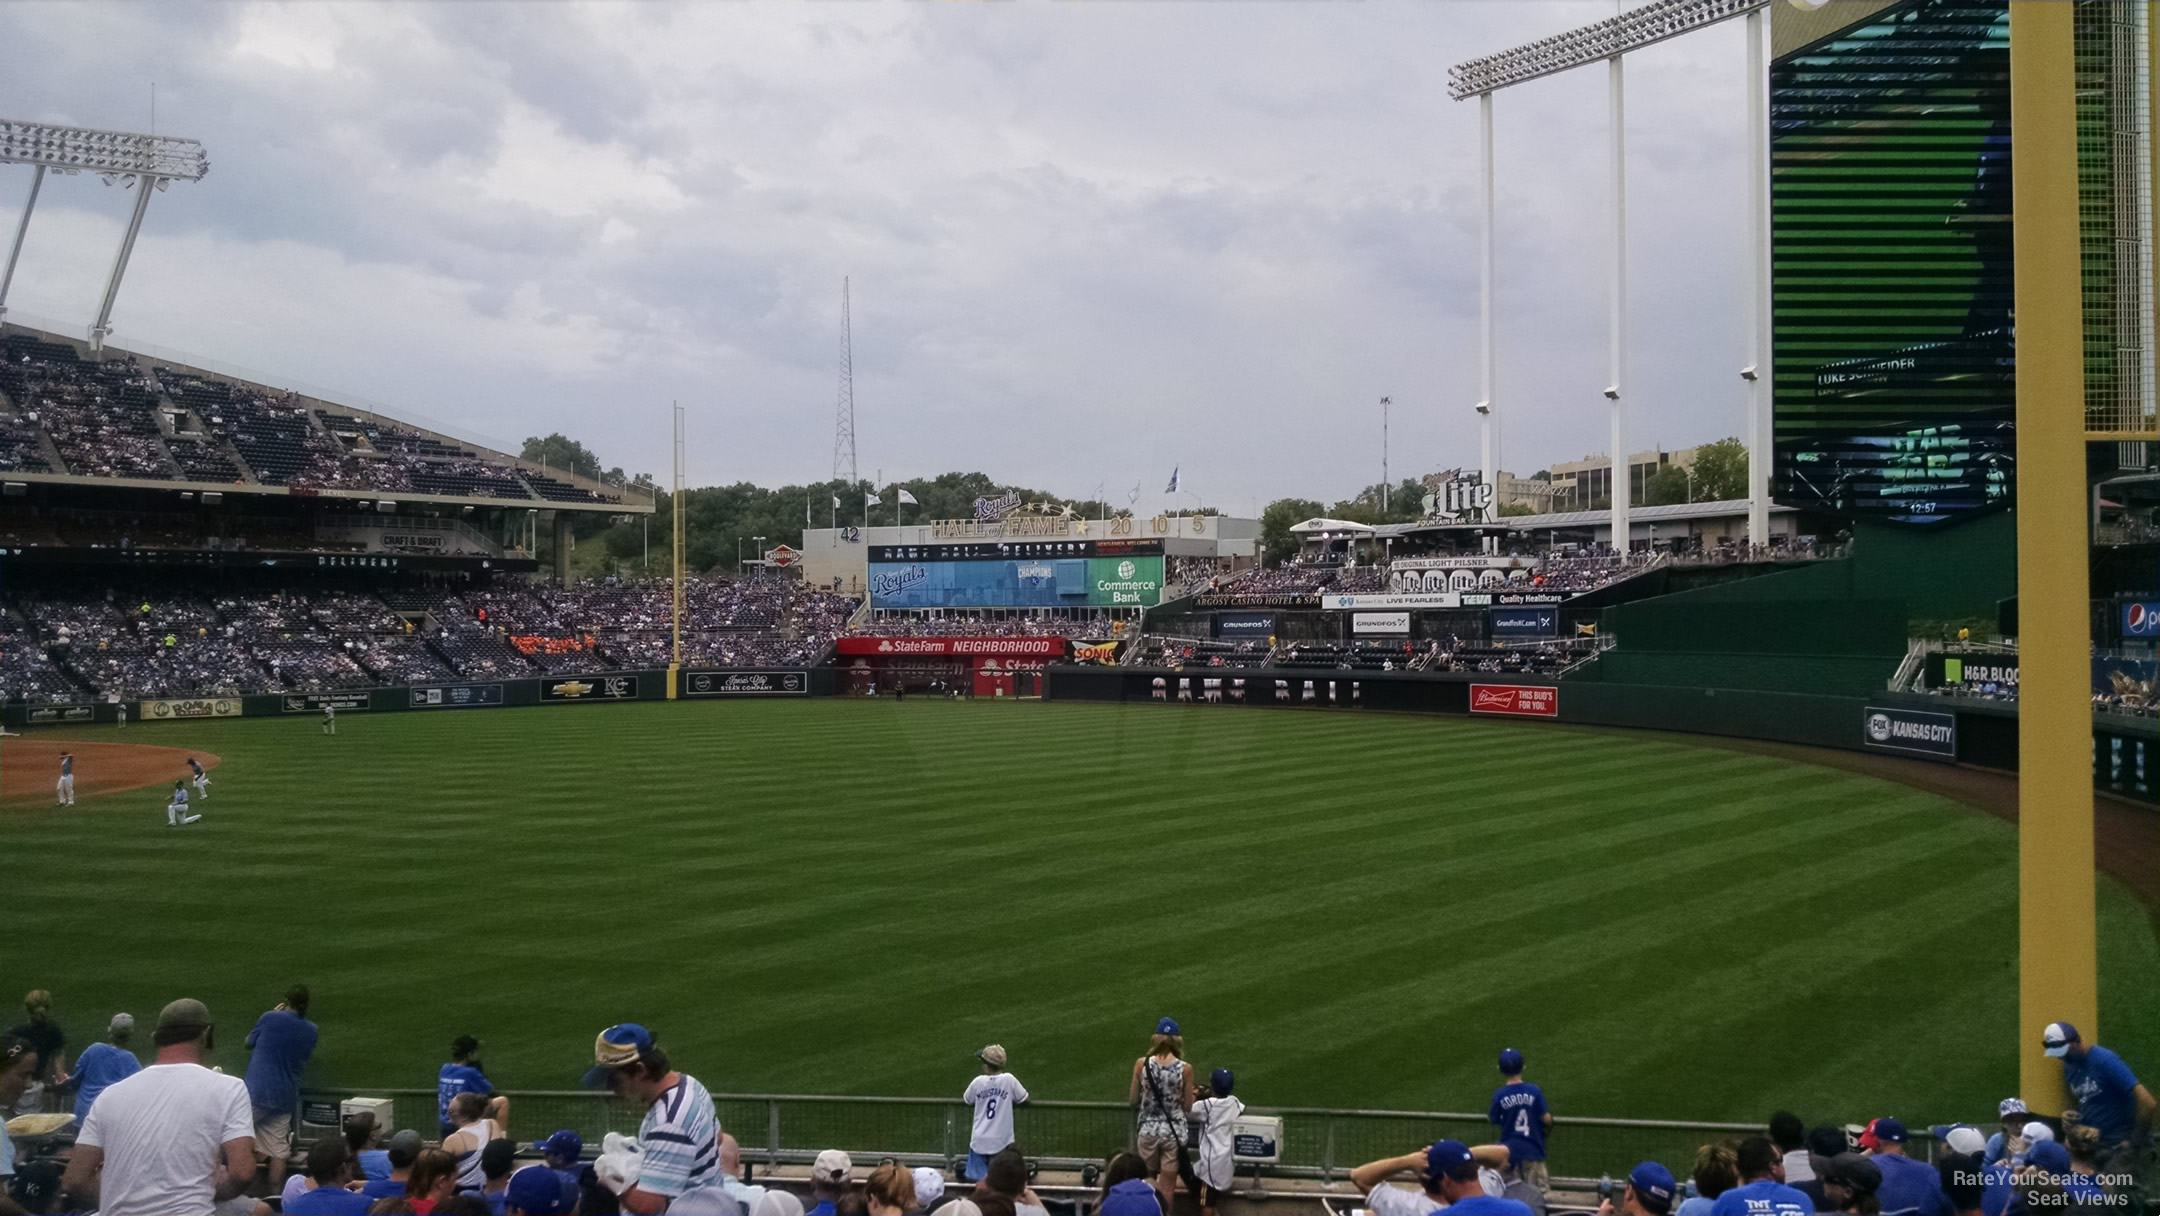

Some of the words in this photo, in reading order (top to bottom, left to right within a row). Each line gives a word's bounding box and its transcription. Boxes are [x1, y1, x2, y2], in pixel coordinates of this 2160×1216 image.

[1817, 372, 1846, 386] LUKE
[973, 489, 1022, 520] Royals
[1437, 480, 1493, 519] Lite
[1910, 502, 1937, 514] 12:57
[930, 519, 986, 538] HALL
[988, 520, 1008, 541] of
[1007, 516, 1068, 536] FAME
[1110, 517, 1133, 536] 20
[1151, 516, 1169, 535] 10
[1192, 514, 1205, 535] 5
[384, 536, 409, 546] CRAFT
[410, 536, 416, 546] &
[417, 536, 442, 547] DRAFT
[840, 526, 861, 544] 42
[1018, 568, 1052, 578] CHAMPIONS
[873, 565, 928, 599] Royals
[1097, 580, 1156, 591] Commerce
[1424, 576, 1445, 592] Lite
[1452, 575, 1474, 591] Lite
[1113, 592, 1141, 603] Bank
[1195, 598, 1228, 606] ARGOSY
[1265, 597, 1294, 605] HOTEL
[1303, 597, 1320, 605] SPA
[1499, 594, 1524, 605] Quality
[1525, 594, 1562, 603] Healthcare
[953, 641, 1049, 653] NEIGHBORHOOD
[1074, 648, 1115, 660] SONIC
[1964, 665, 1989, 681] H&R
[1518, 690, 1533, 700] THIS
[1534, 691, 1553, 701] BUD'S
[1518, 701, 1531, 710] FOR
[1532, 702, 1547, 711] YOU.
[1873, 719, 1890, 730] FOX
[1892, 720, 1931, 741] KANSAS
[1931, 724, 1953, 743] CITY
[986, 1099, 997, 1120] 8
[1500, 1093, 1536, 1110] GORDON
[1514, 1109, 1530, 1137] 4
[1744, 1199, 1771, 1209] TNT
